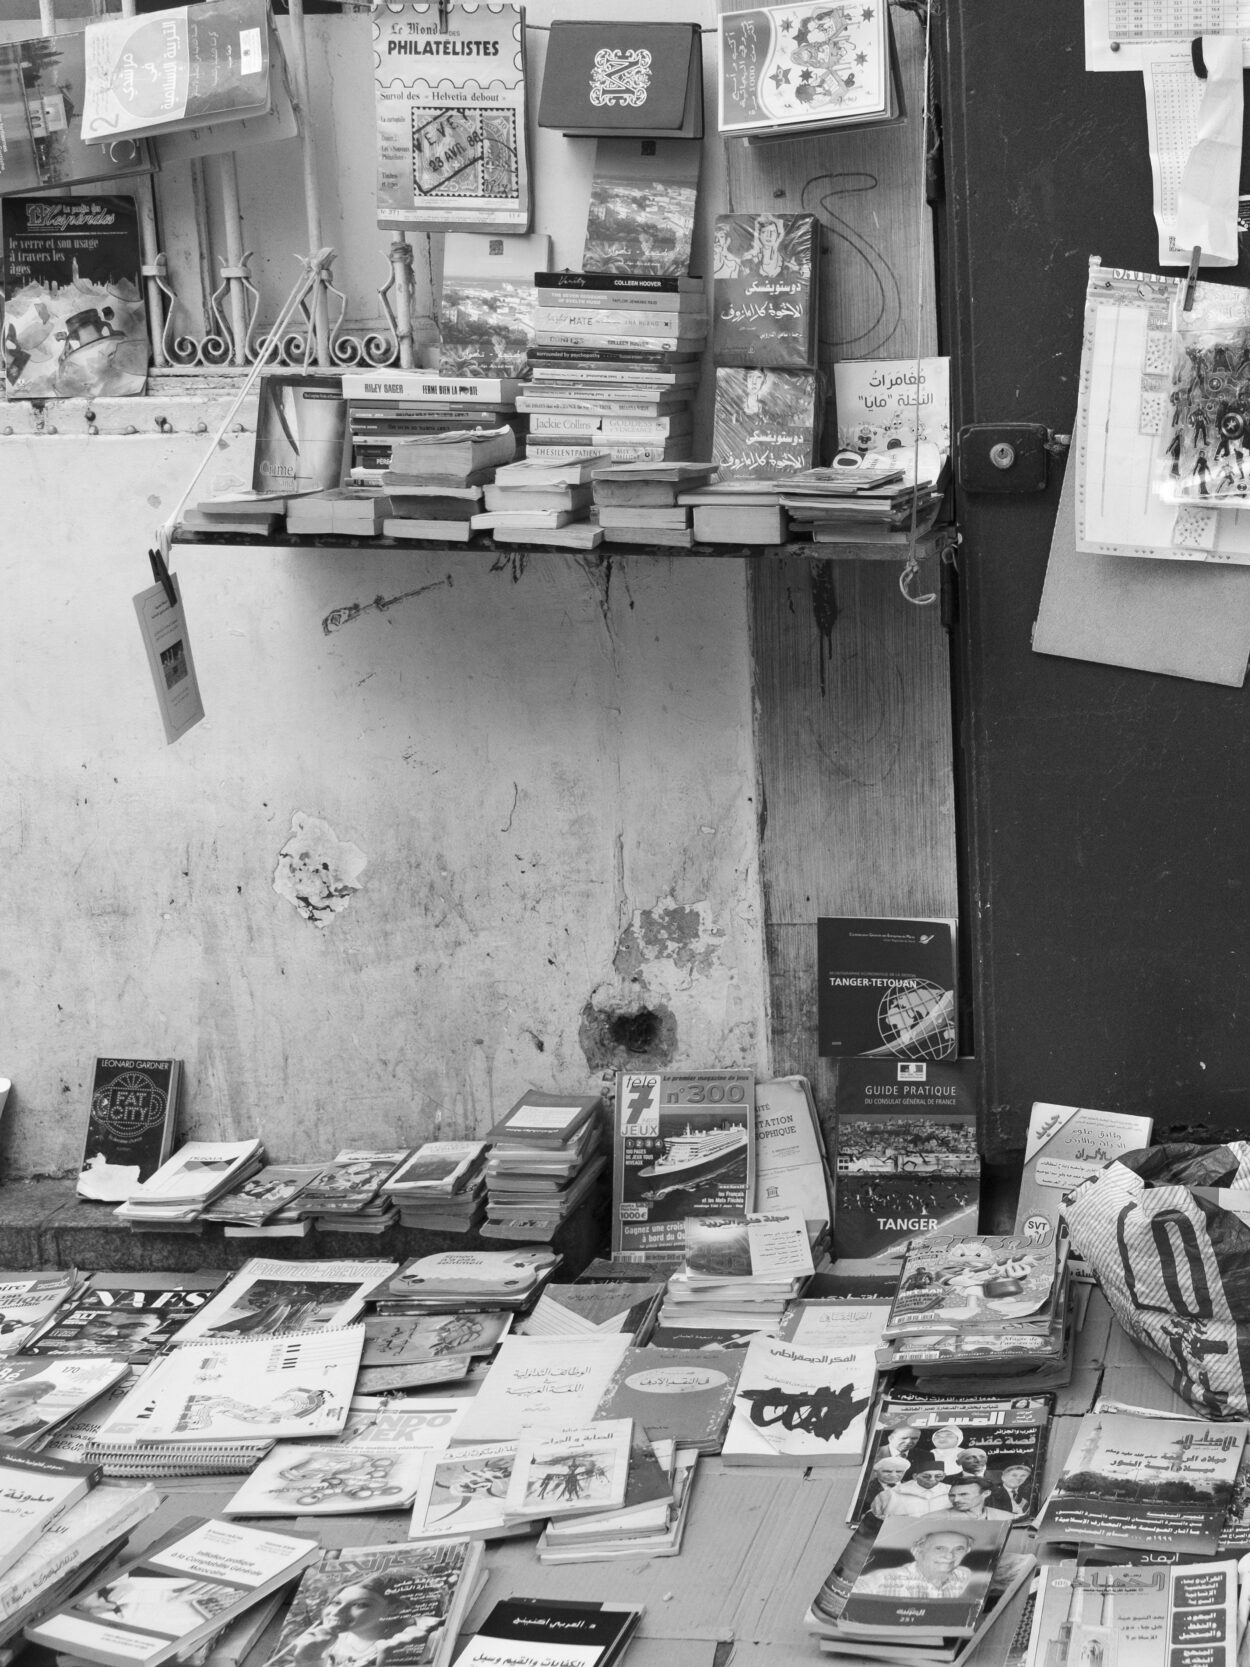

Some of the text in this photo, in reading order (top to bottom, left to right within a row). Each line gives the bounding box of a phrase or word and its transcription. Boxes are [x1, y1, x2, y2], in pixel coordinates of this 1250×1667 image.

[391, 22, 403, 35] Le
[406, 22, 442, 35] Mond
[163, 20, 181, 58] التربية
[387, 39, 499, 57] PHILATÉLISTES
[432, 91, 467, 101] Helvetia
[471, 92, 500, 102] debout
[89, 113, 119, 132] 2
[9, 236, 99, 251] le verre et son usage
[18, 251, 51, 262] travers
[53, 249, 65, 262] les
[614, 279, 639, 287] COLLEEN
[569, 316, 593, 326] HATE
[364, 383, 382, 393] RILEY
[383, 383, 404, 394] SAGER
[534, 417, 591, 431] Jackie Collins
[259, 460, 295, 477] Crime
[829, 977, 917, 988] TANGER-TETOUAN
[100, 1059, 169, 1071] LEONARD GARDNER
[687, 1082, 745, 1104] 300
[865, 1085, 956, 1096] GUIDE PRATIQUE
[116, 1091, 145, 1105] FAT
[902, 1097, 927, 1105] GÉNÉRAL
[111, 1107, 147, 1122] CITY
[622, 1125, 658, 1135] JEUX
[624, 1225, 650, 1236] Gagnez
[877, 1218, 938, 1231] TANGER
[1027, 1220, 1048, 1231] SVT
[649, 1233, 664, 1242] bord
[666, 1232, 675, 1241] du
[250, 1262, 391, 1279] PHOTO-REVUE
[828, 1354, 856, 1365] الفكر
[910, 1411, 1006, 1427] المساء
[968, 1434, 1037, 1447] قصة عقدة
